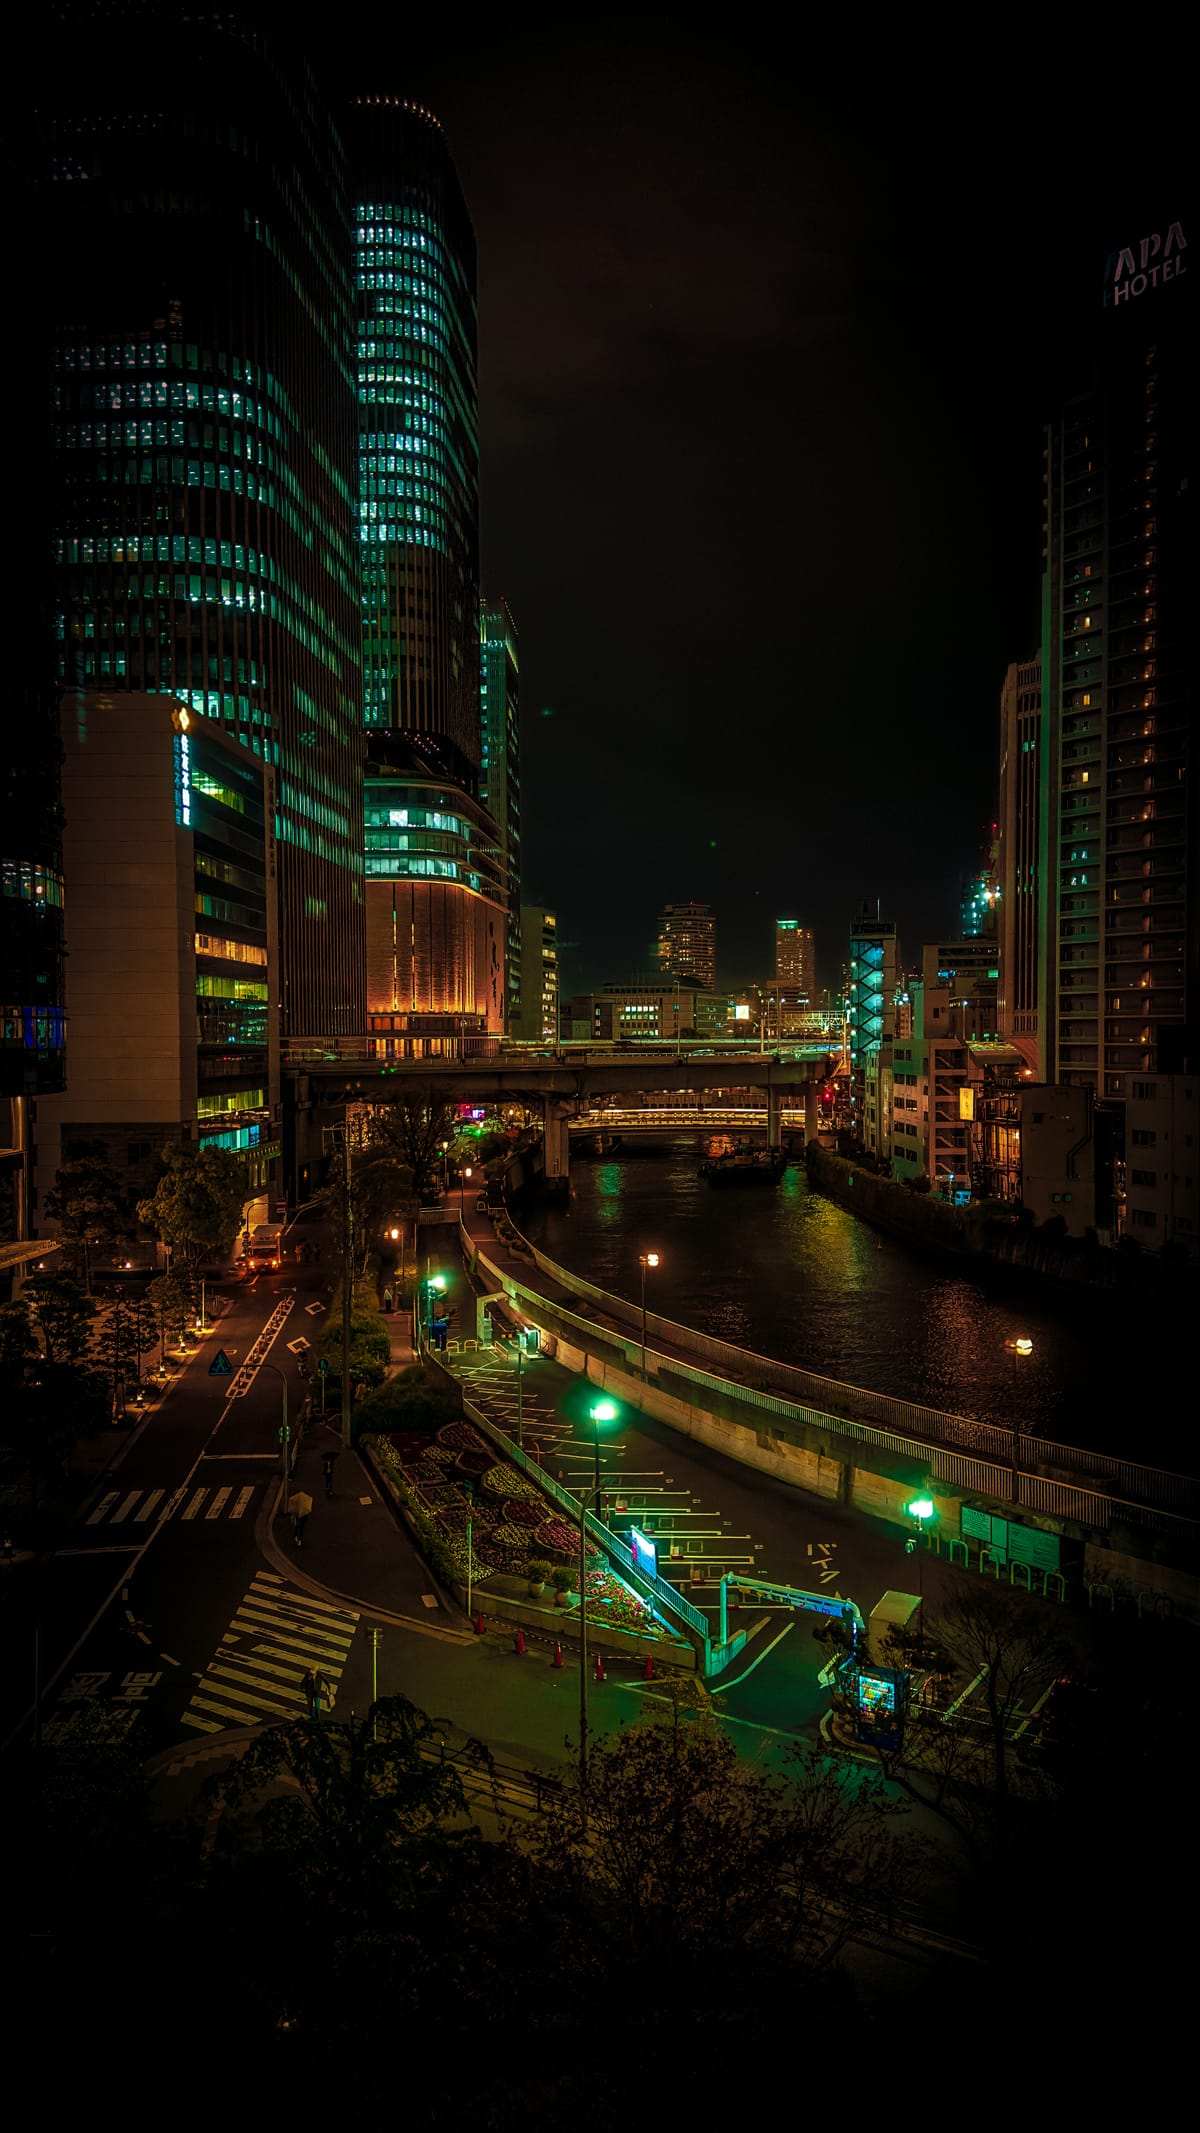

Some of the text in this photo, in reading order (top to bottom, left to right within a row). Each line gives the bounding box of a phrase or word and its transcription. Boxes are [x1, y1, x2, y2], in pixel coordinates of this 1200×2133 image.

[1113, 220, 1188, 282] APA
[1113, 254, 1188, 307] HOTEL
[807, 1543, 841, 1584] バイク
